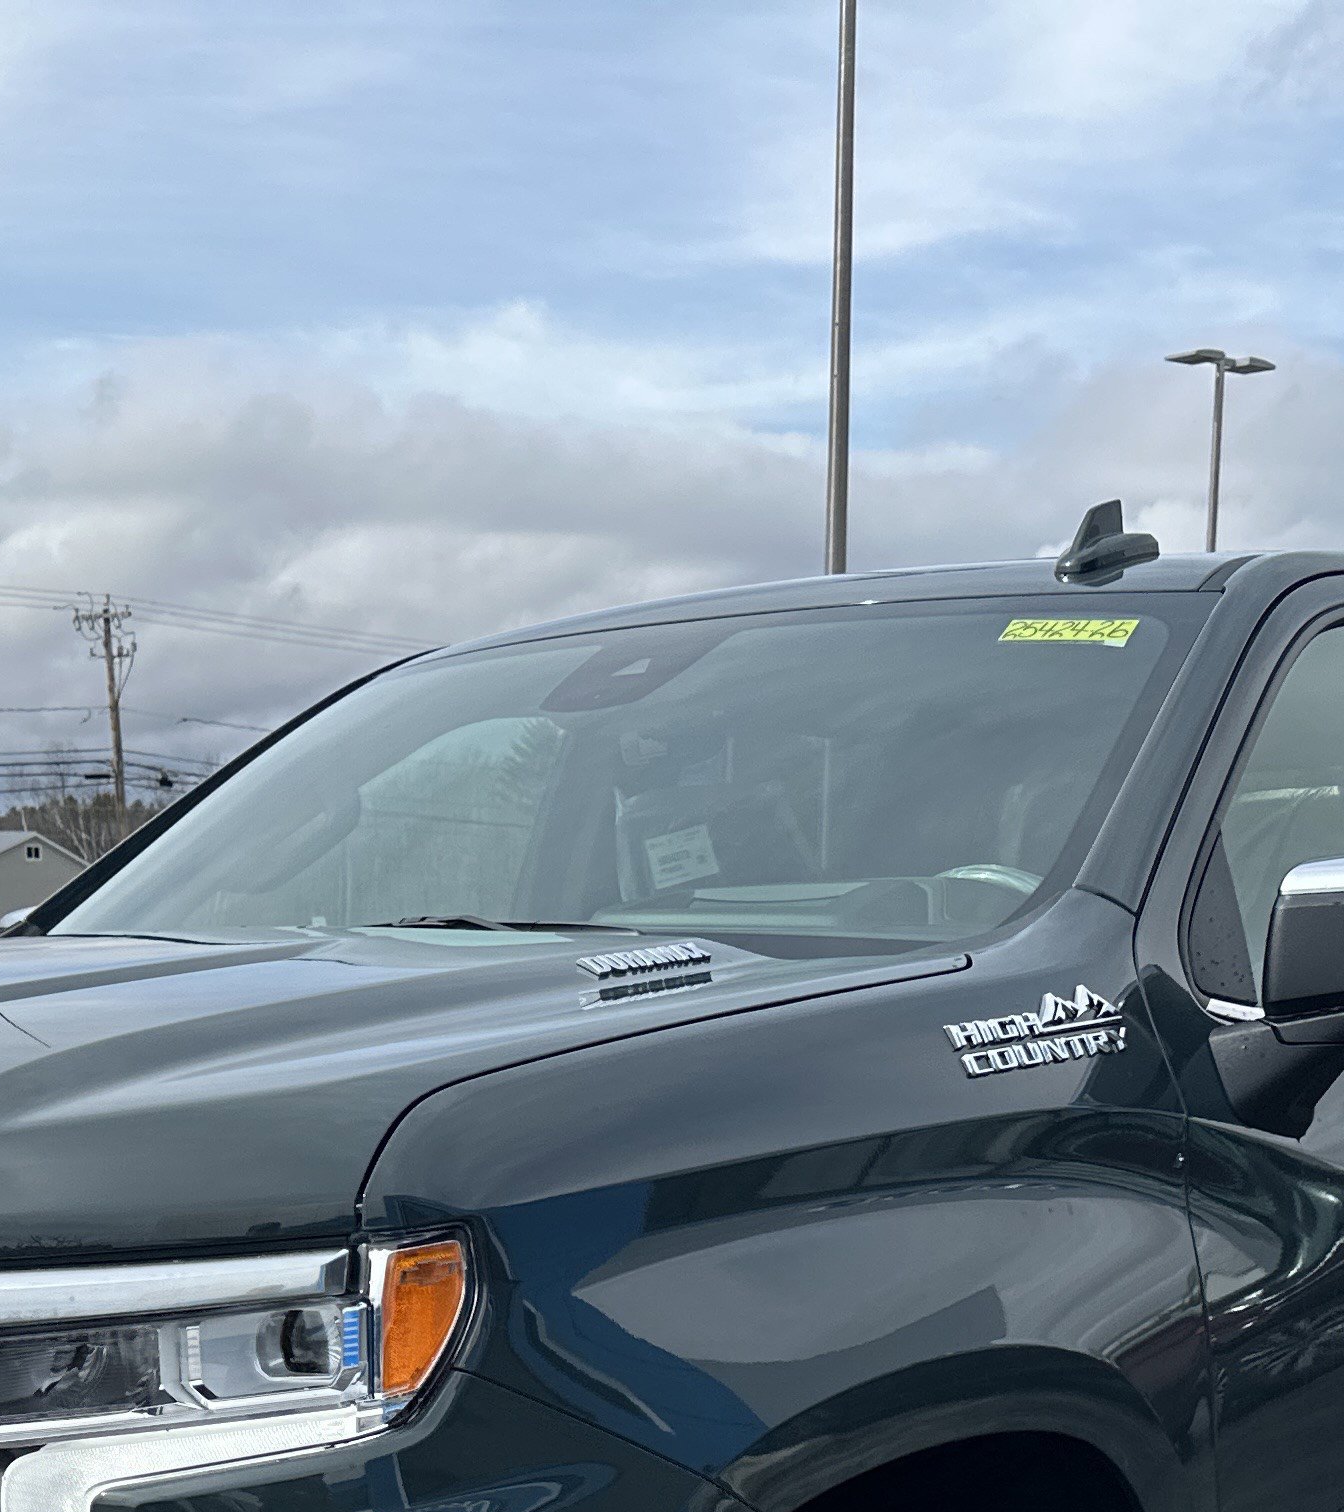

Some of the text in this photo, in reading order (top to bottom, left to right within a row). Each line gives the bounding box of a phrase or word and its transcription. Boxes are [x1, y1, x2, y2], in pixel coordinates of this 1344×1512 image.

[575, 941, 712, 979] DURAMAX
[943, 1012, 1044, 1050] HIGH
[960, 1027, 1127, 1078] COUNTRY
